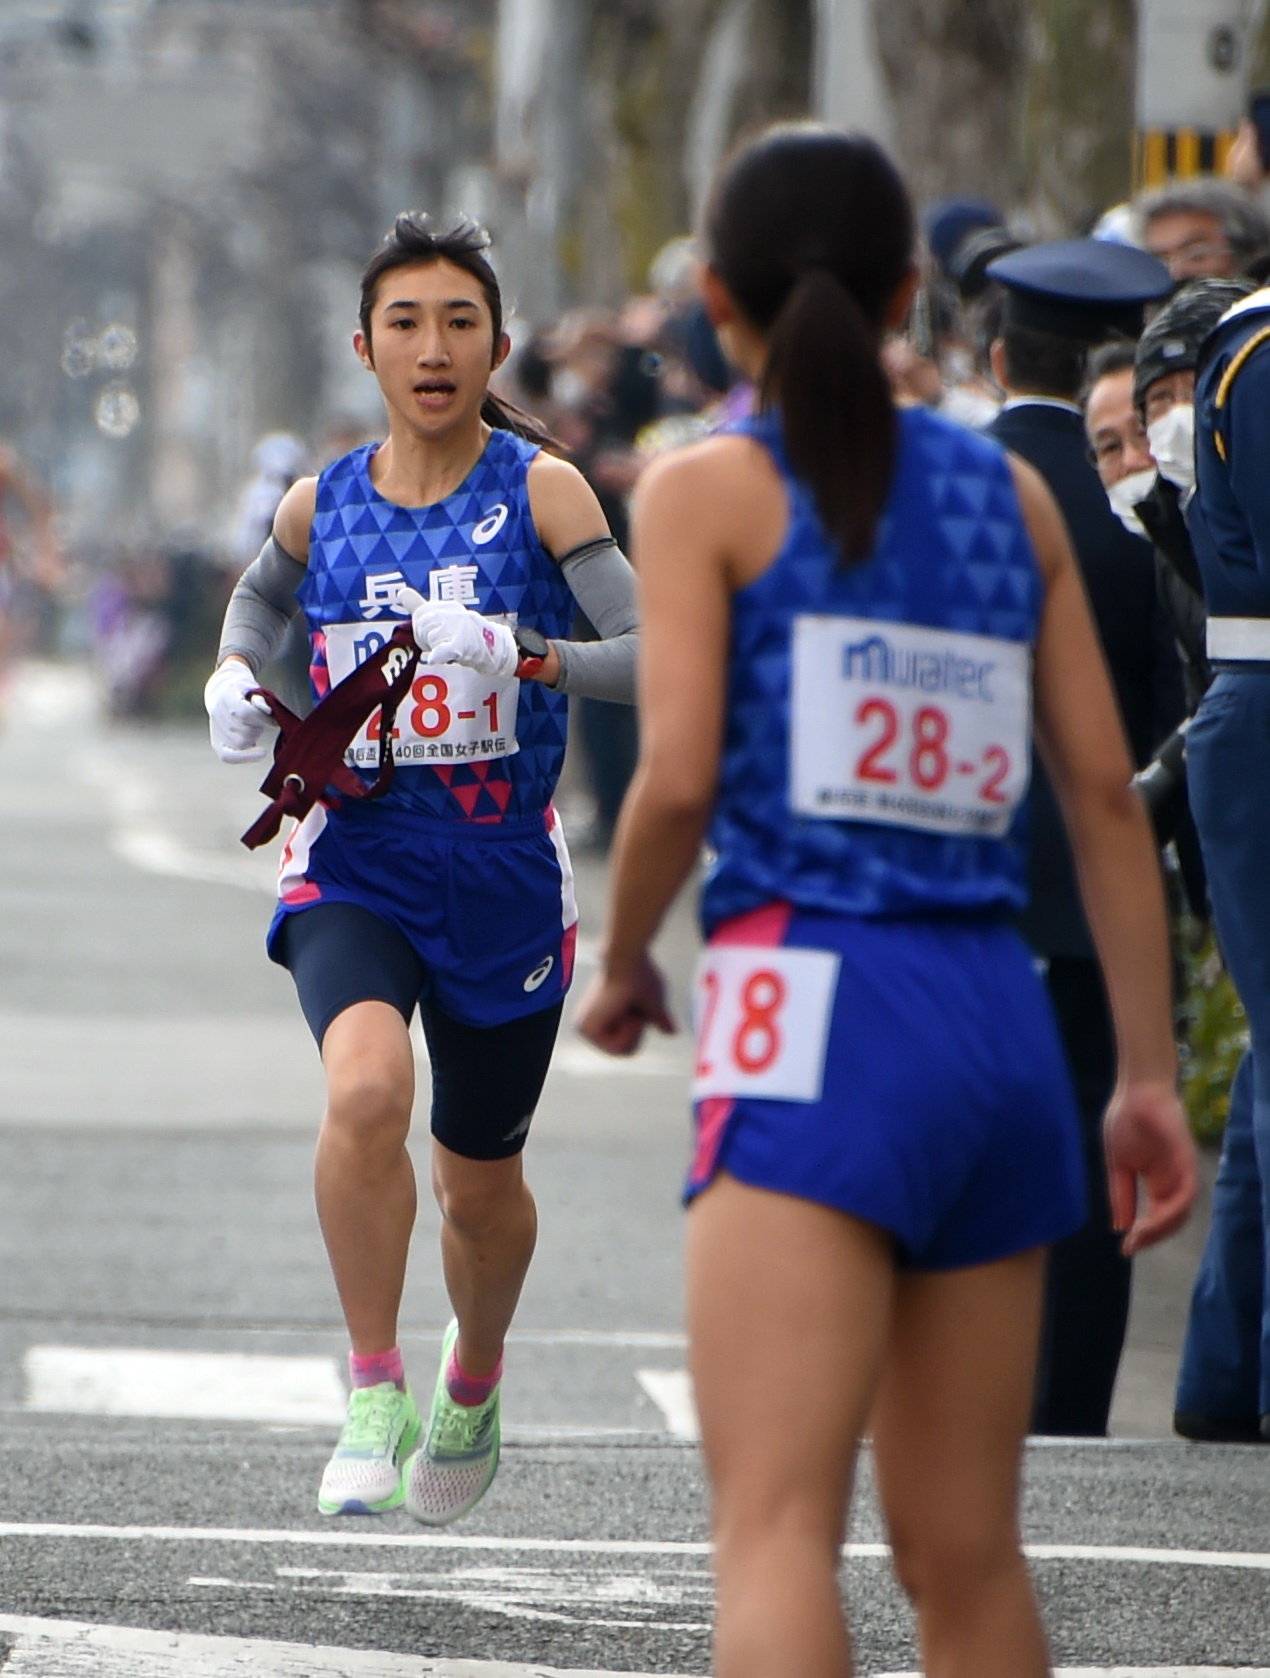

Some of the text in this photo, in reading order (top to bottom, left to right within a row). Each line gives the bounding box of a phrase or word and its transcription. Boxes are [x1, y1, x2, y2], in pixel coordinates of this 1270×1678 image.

[359, 565, 480, 619] 兵庫
[390, 738, 506, 759] 40回全国女子駅伝
[856, 698, 1010, 803] 28-2
